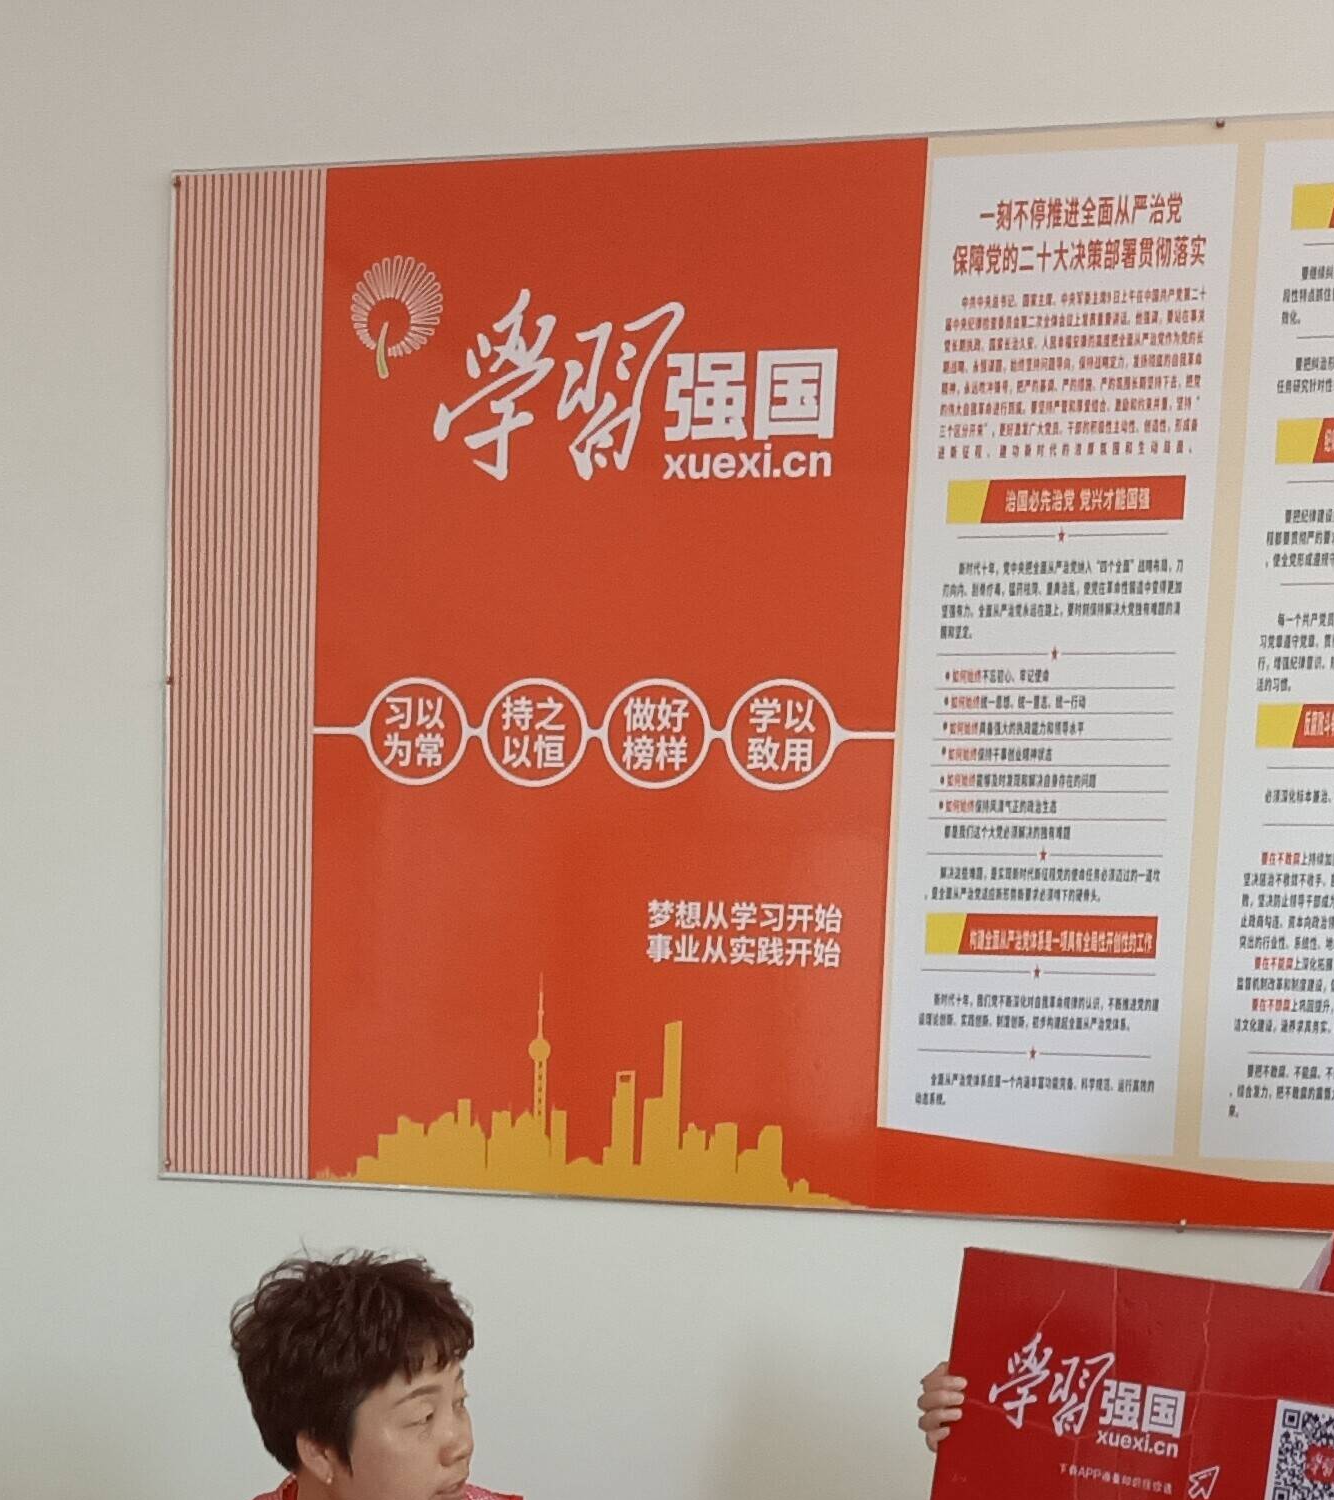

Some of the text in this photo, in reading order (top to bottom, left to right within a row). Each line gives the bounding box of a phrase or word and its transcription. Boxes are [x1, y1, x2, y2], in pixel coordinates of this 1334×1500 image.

[979, 193, 1183, 231] 一刻不停推进全面从严治党
[952, 235, 1207, 275] 保障党的二十大决策部署贯彻落实
[664, 443, 833, 480] xuexi.cn
[1004, 486, 1151, 513] 治国必先治党 党兴才能国强
[383, 695, 445, 728] 习以
[502, 697, 566, 730] 持之
[623, 697, 691, 732] 做好
[749, 698, 816, 735] 学以
[383, 733, 444, 769] 为常
[502, 736, 566, 769] 以恒
[622, 737, 688, 771] 榜样
[747, 738, 813, 773] 致用
[647, 899, 842, 933] 梦想从学习开始
[646, 934, 842, 968] 事业从实践开始
[1096, 1429, 1180, 1458] xuexi.cn
